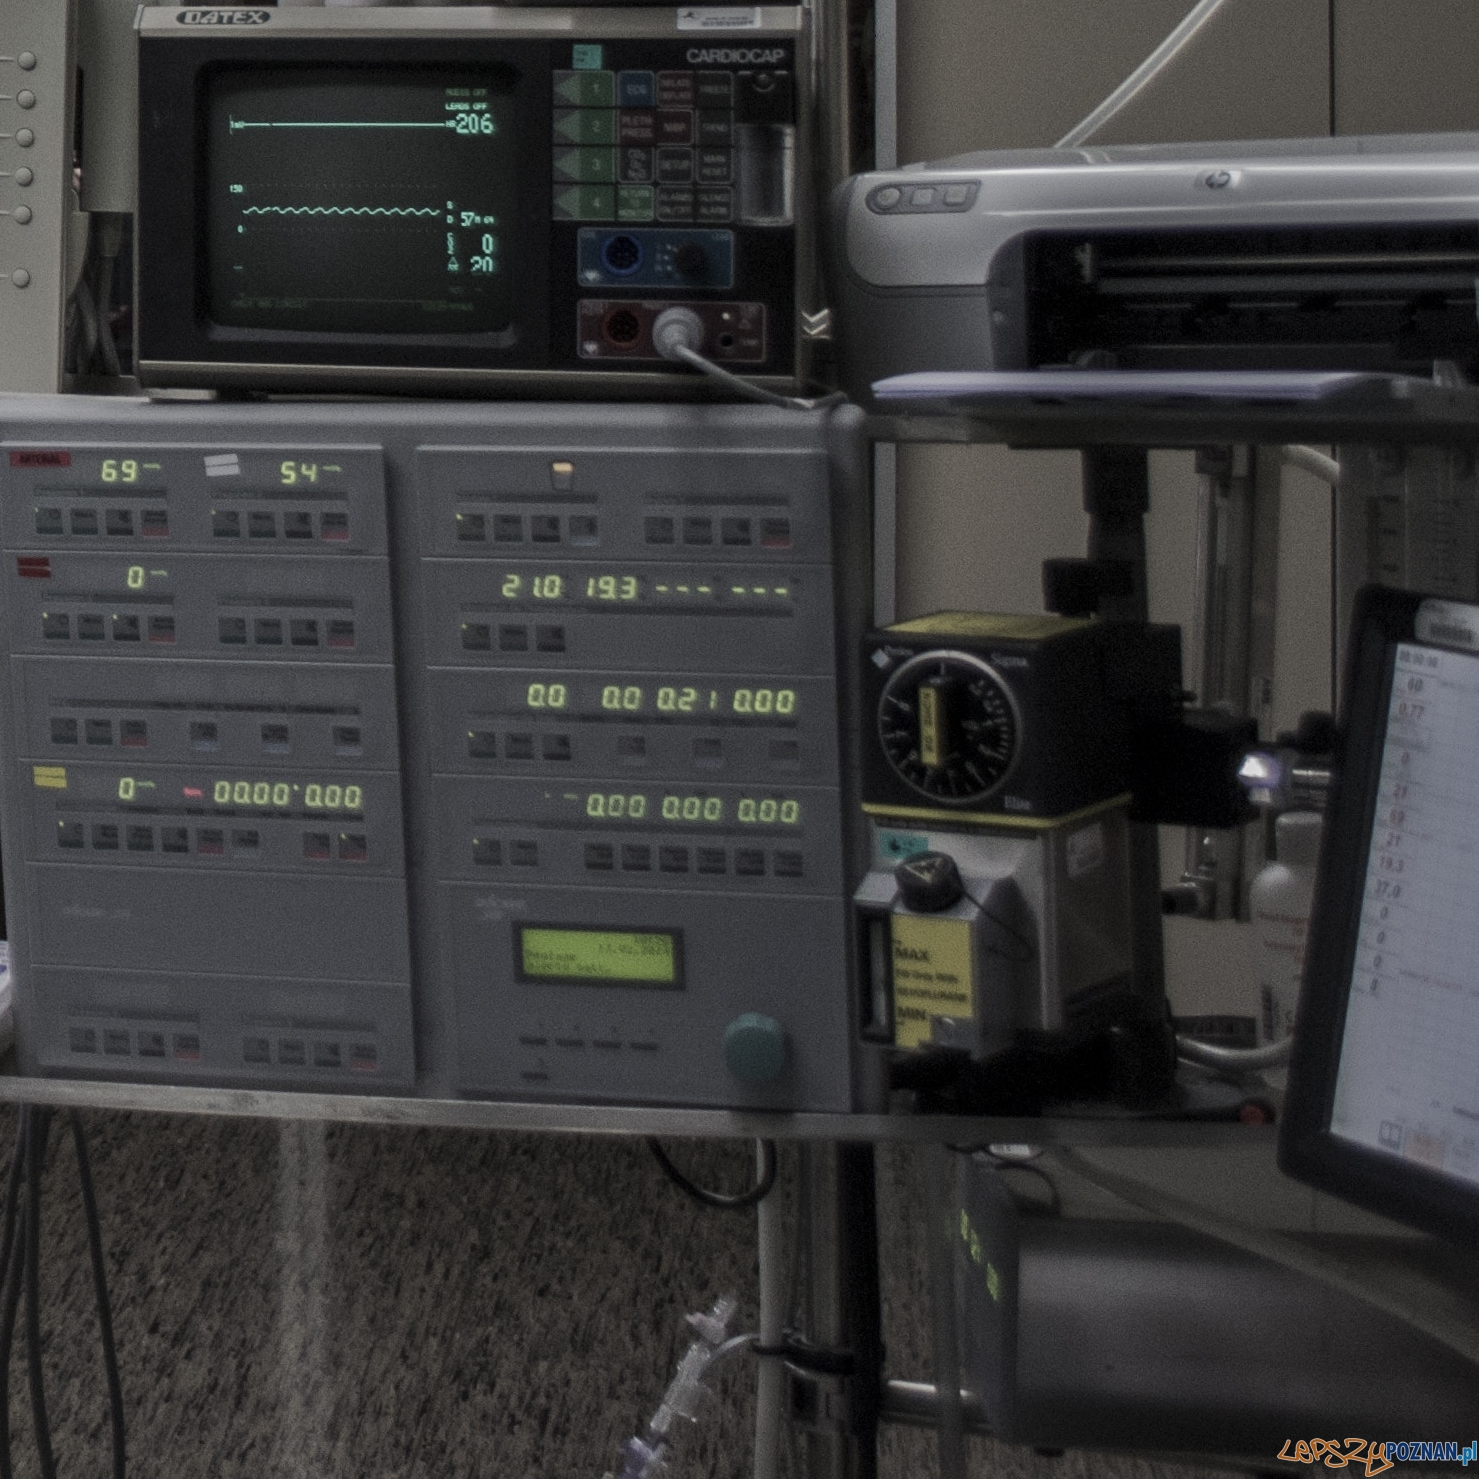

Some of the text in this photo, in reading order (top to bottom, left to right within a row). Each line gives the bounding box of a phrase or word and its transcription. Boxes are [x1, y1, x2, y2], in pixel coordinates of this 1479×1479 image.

[182, 11, 265, 24] DATEX
[686, 48, 785, 64] CARDIOCAP
[472, 101, 488, 112] OFF
[455, 112, 495, 135] 206
[592, 158, 600, 171] 3
[592, 197, 601, 208] 4
[481, 233, 494, 254] 0
[100, 458, 138, 483] 69
[280, 461, 317, 485] 54
[127, 566, 144, 590] 0
[118, 777, 135, 800] 0
[895, 947, 930, 962] MAX
[897, 1007, 927, 1021] MIN
